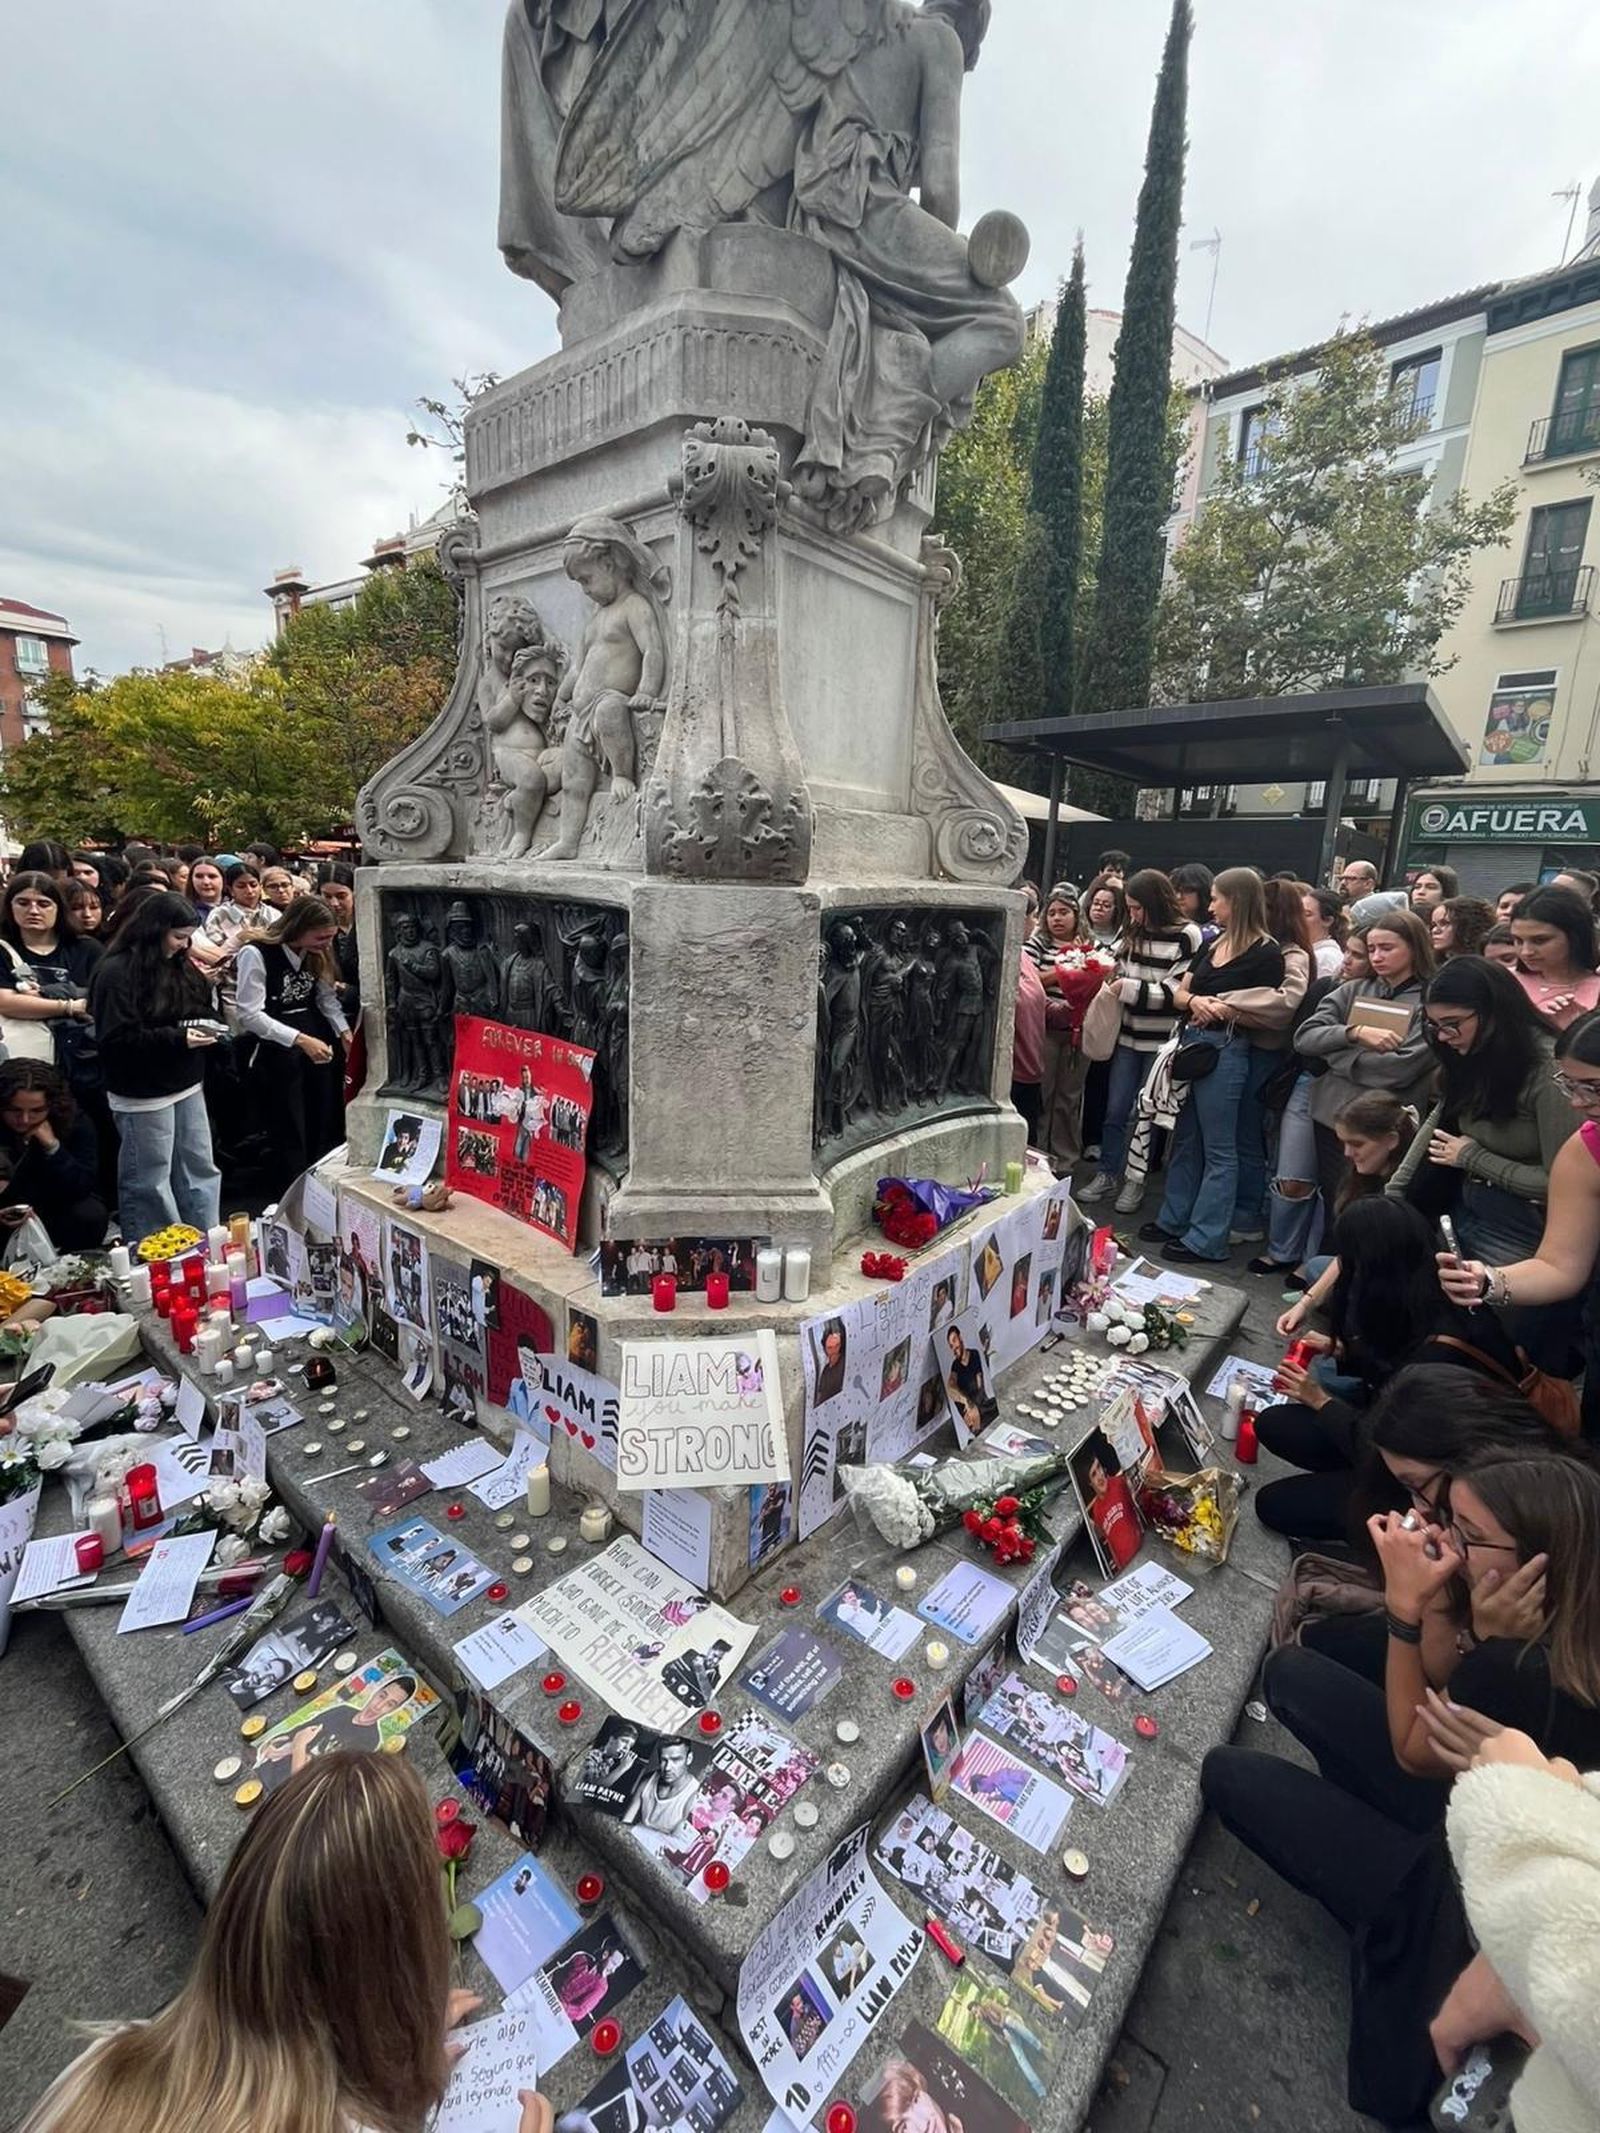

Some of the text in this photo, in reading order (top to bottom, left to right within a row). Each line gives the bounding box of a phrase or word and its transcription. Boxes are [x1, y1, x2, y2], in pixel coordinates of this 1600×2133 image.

[1446, 810, 1588, 831] AFUERA
[625, 1352, 738, 1398] LIAM
[543, 1368, 596, 1422] LIAM
[627, 1396, 762, 1426] you make
[620, 1422, 777, 1476] STRONG
[580, 1560, 625, 1597] FORGET
[633, 1566, 661, 1590] CAN
[557, 1620, 581, 1642] TO
[579, 1633, 689, 1735] REMEMBER
[785, 1676, 819, 1713] something
[575, 1782, 597, 1792] LIAM
[597, 1786, 626, 1803] PAYNE
[715, 1750, 780, 1807] PAYNE
[887, 1929, 923, 1977] PAYNE
[533, 1970, 563, 2016] REMEMBER
[497, 2020, 525, 2042] algo
[748, 2015, 769, 2042] REST
[759, 2034, 772, 2047] IN
[758, 2036, 784, 2067] PEACE
[471, 2058, 513, 2086] Seguro
[516, 2054, 535, 2072] que
[466, 2084, 512, 2107] leyendo
